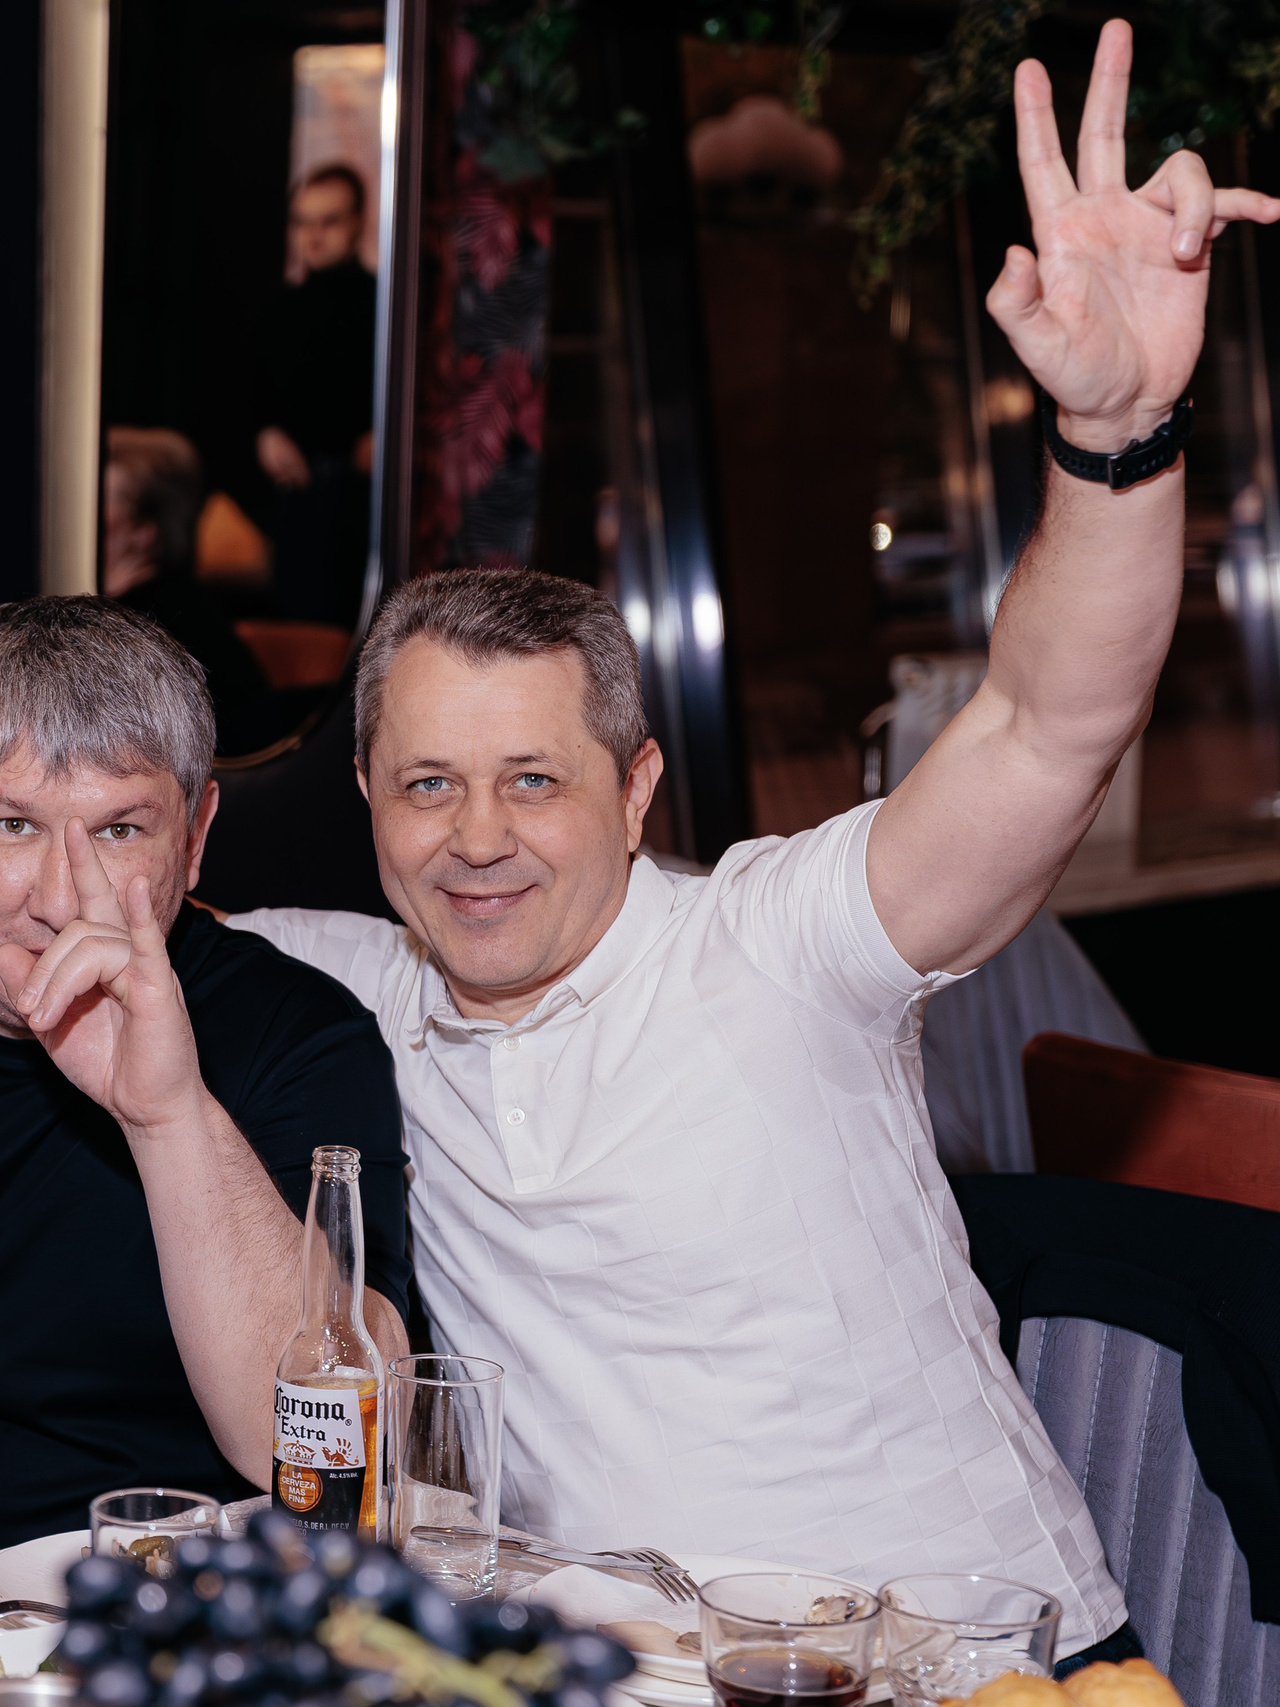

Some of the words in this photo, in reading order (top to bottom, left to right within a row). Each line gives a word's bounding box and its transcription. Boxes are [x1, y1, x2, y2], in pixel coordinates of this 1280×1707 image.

[274, 1384, 346, 1420] Corona
[281, 1415, 326, 1441] Extra
[291, 1471, 302, 1479] LA
[281, 1476, 316, 1490] CERVEZA
[288, 1486, 306, 1496] MAS
[288, 1494, 306, 1504] FINA
